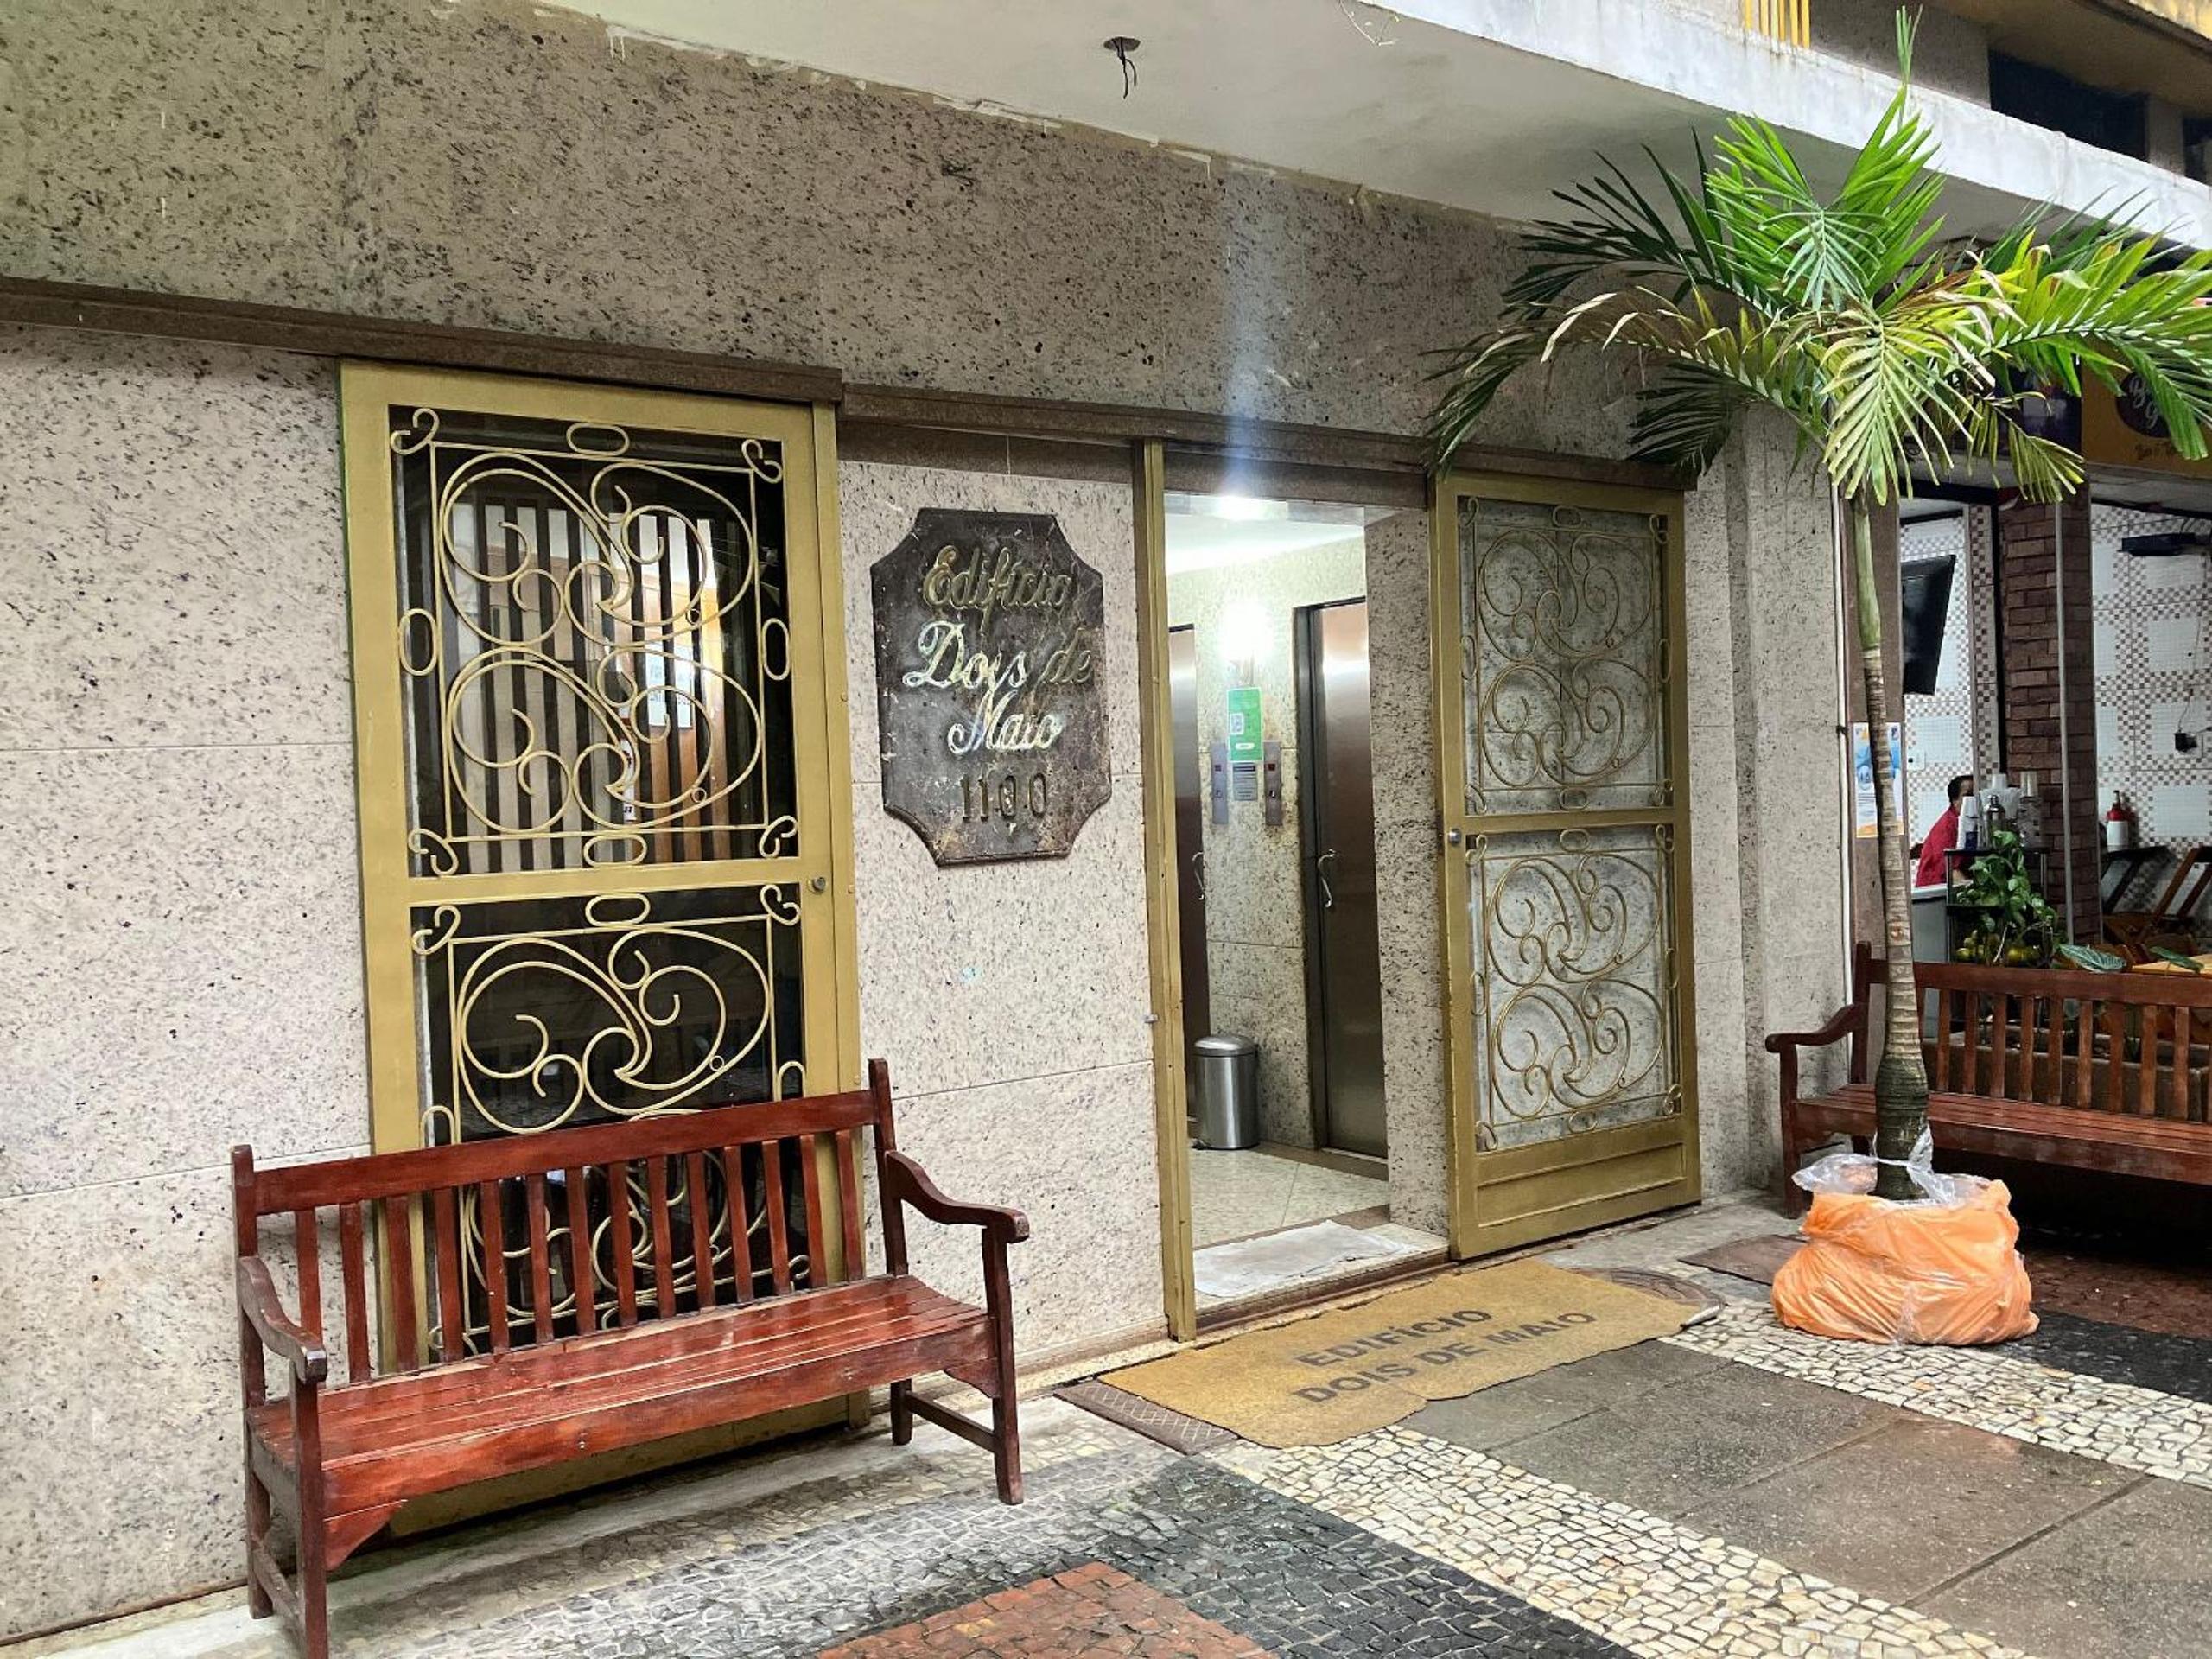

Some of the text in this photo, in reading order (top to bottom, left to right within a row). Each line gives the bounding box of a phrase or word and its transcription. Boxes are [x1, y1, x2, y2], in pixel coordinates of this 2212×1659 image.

[947, 690, 1064, 754] Maio
[961, 772, 1047, 822] 1100
[1292, 1311, 1598, 1403] DOIS DE MAIO
